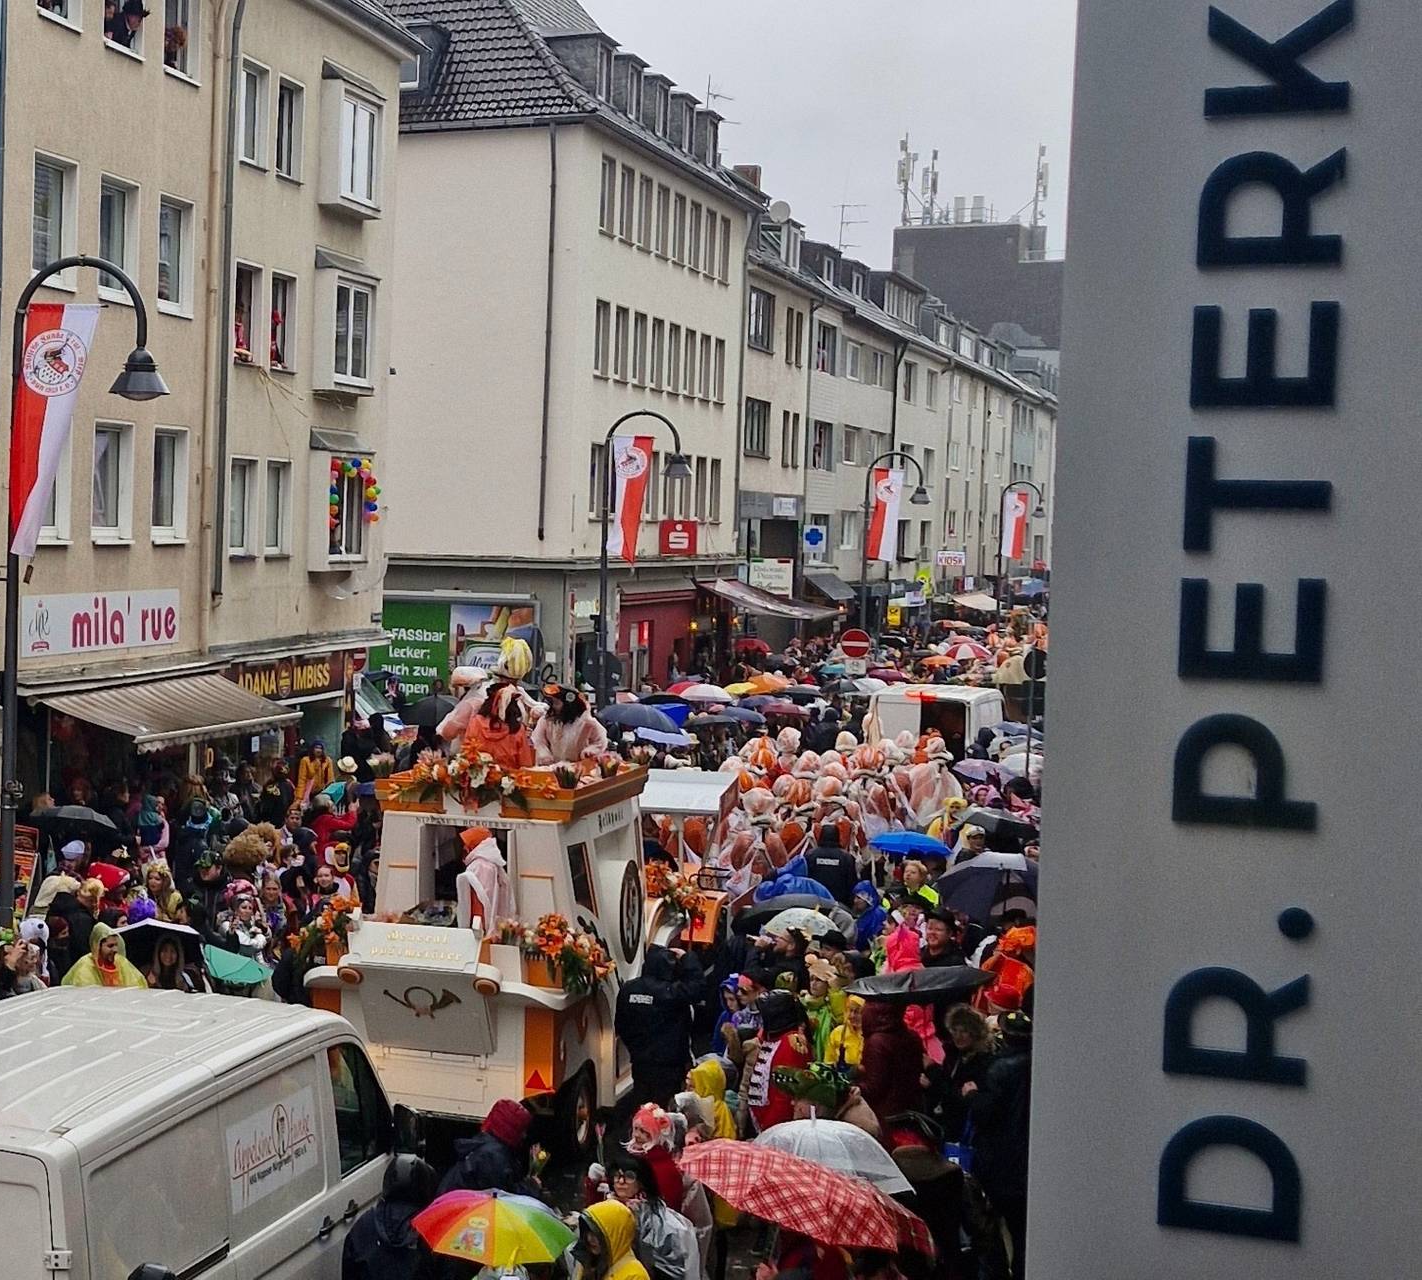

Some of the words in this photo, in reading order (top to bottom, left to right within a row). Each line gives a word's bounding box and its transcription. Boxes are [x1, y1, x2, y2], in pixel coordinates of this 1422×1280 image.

[938, 555, 963, 566] KIOSK
[141, 606, 177, 642] rue
[293, 662, 330, 690] IMBISS
[1156, 906, 1316, 1244] DR.
